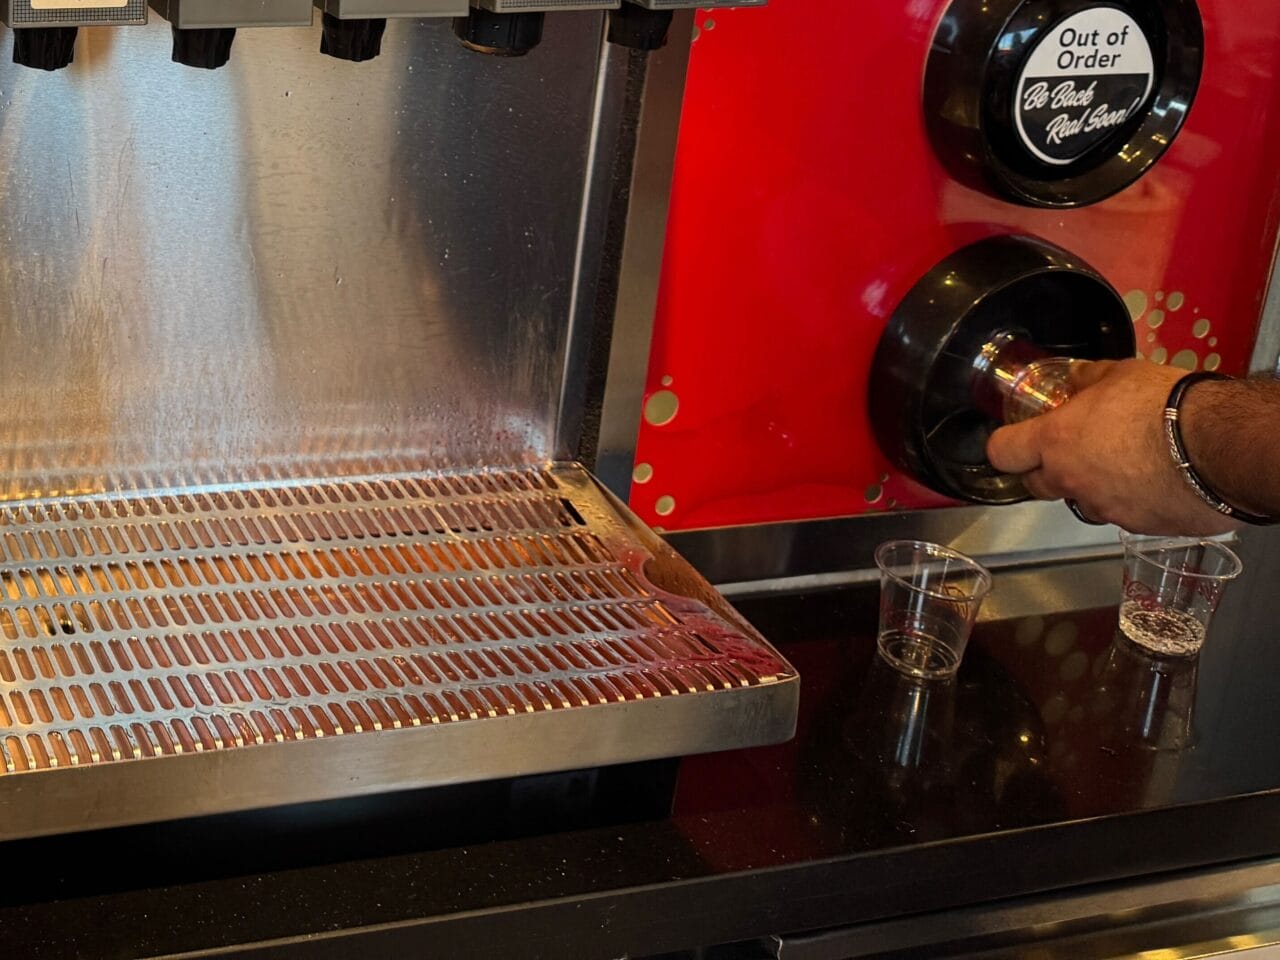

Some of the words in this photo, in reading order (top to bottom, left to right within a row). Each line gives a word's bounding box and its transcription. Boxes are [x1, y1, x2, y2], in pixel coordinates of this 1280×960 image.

[1059, 28, 1099, 47] Out
[1107, 25, 1129, 45] of
[1057, 49, 1121, 69] Order
[1023, 81, 1050, 111] Be
[1051, 80, 1098, 109] Back
[1045, 108, 1091, 144] Real
